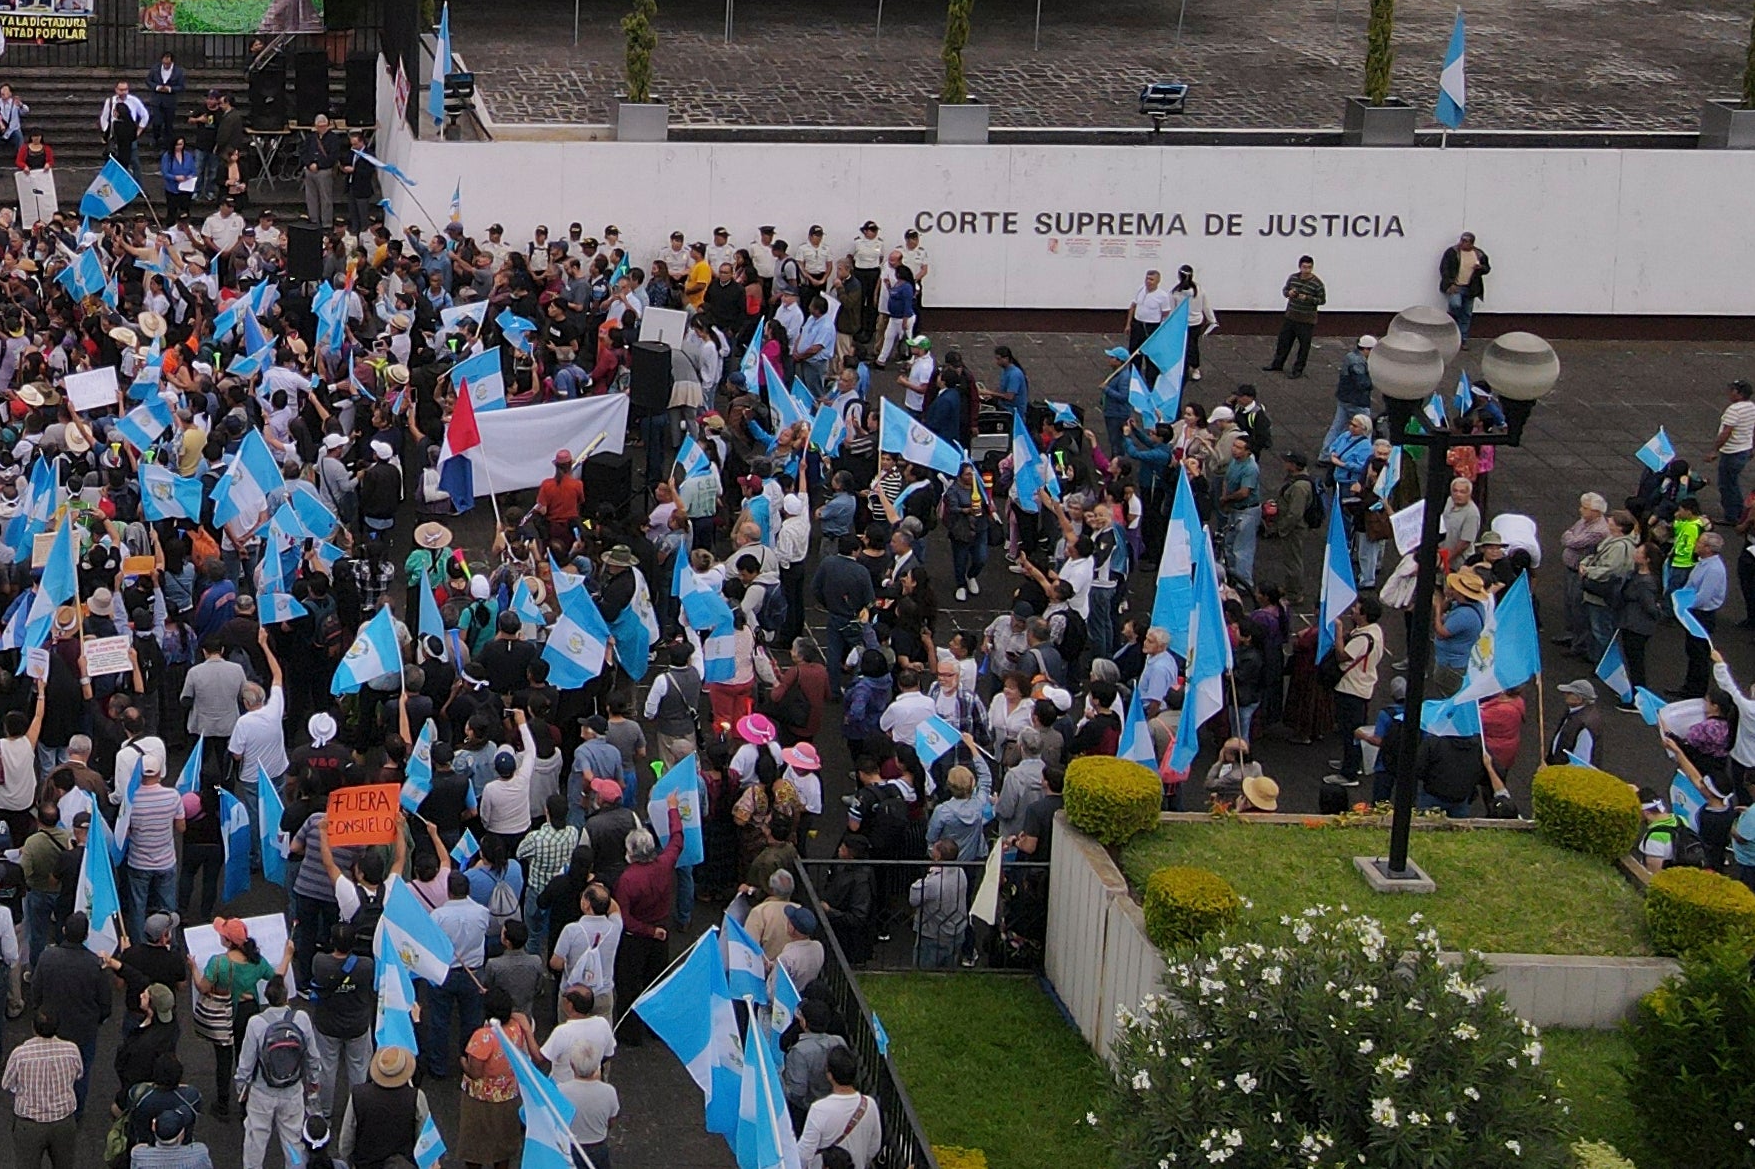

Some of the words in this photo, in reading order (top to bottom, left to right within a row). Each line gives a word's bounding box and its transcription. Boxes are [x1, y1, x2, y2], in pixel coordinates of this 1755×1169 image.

[30, 17, 87, 28] DICTADURA
[35, 28, 87, 40] POPULAR
[913, 210, 1018, 235] CORTE
[1034, 211, 1189, 237] SUPREMA
[1204, 212, 1243, 237] DE
[1258, 213, 1406, 239] JUSTICIA
[332, 790, 390, 813] FUERA
